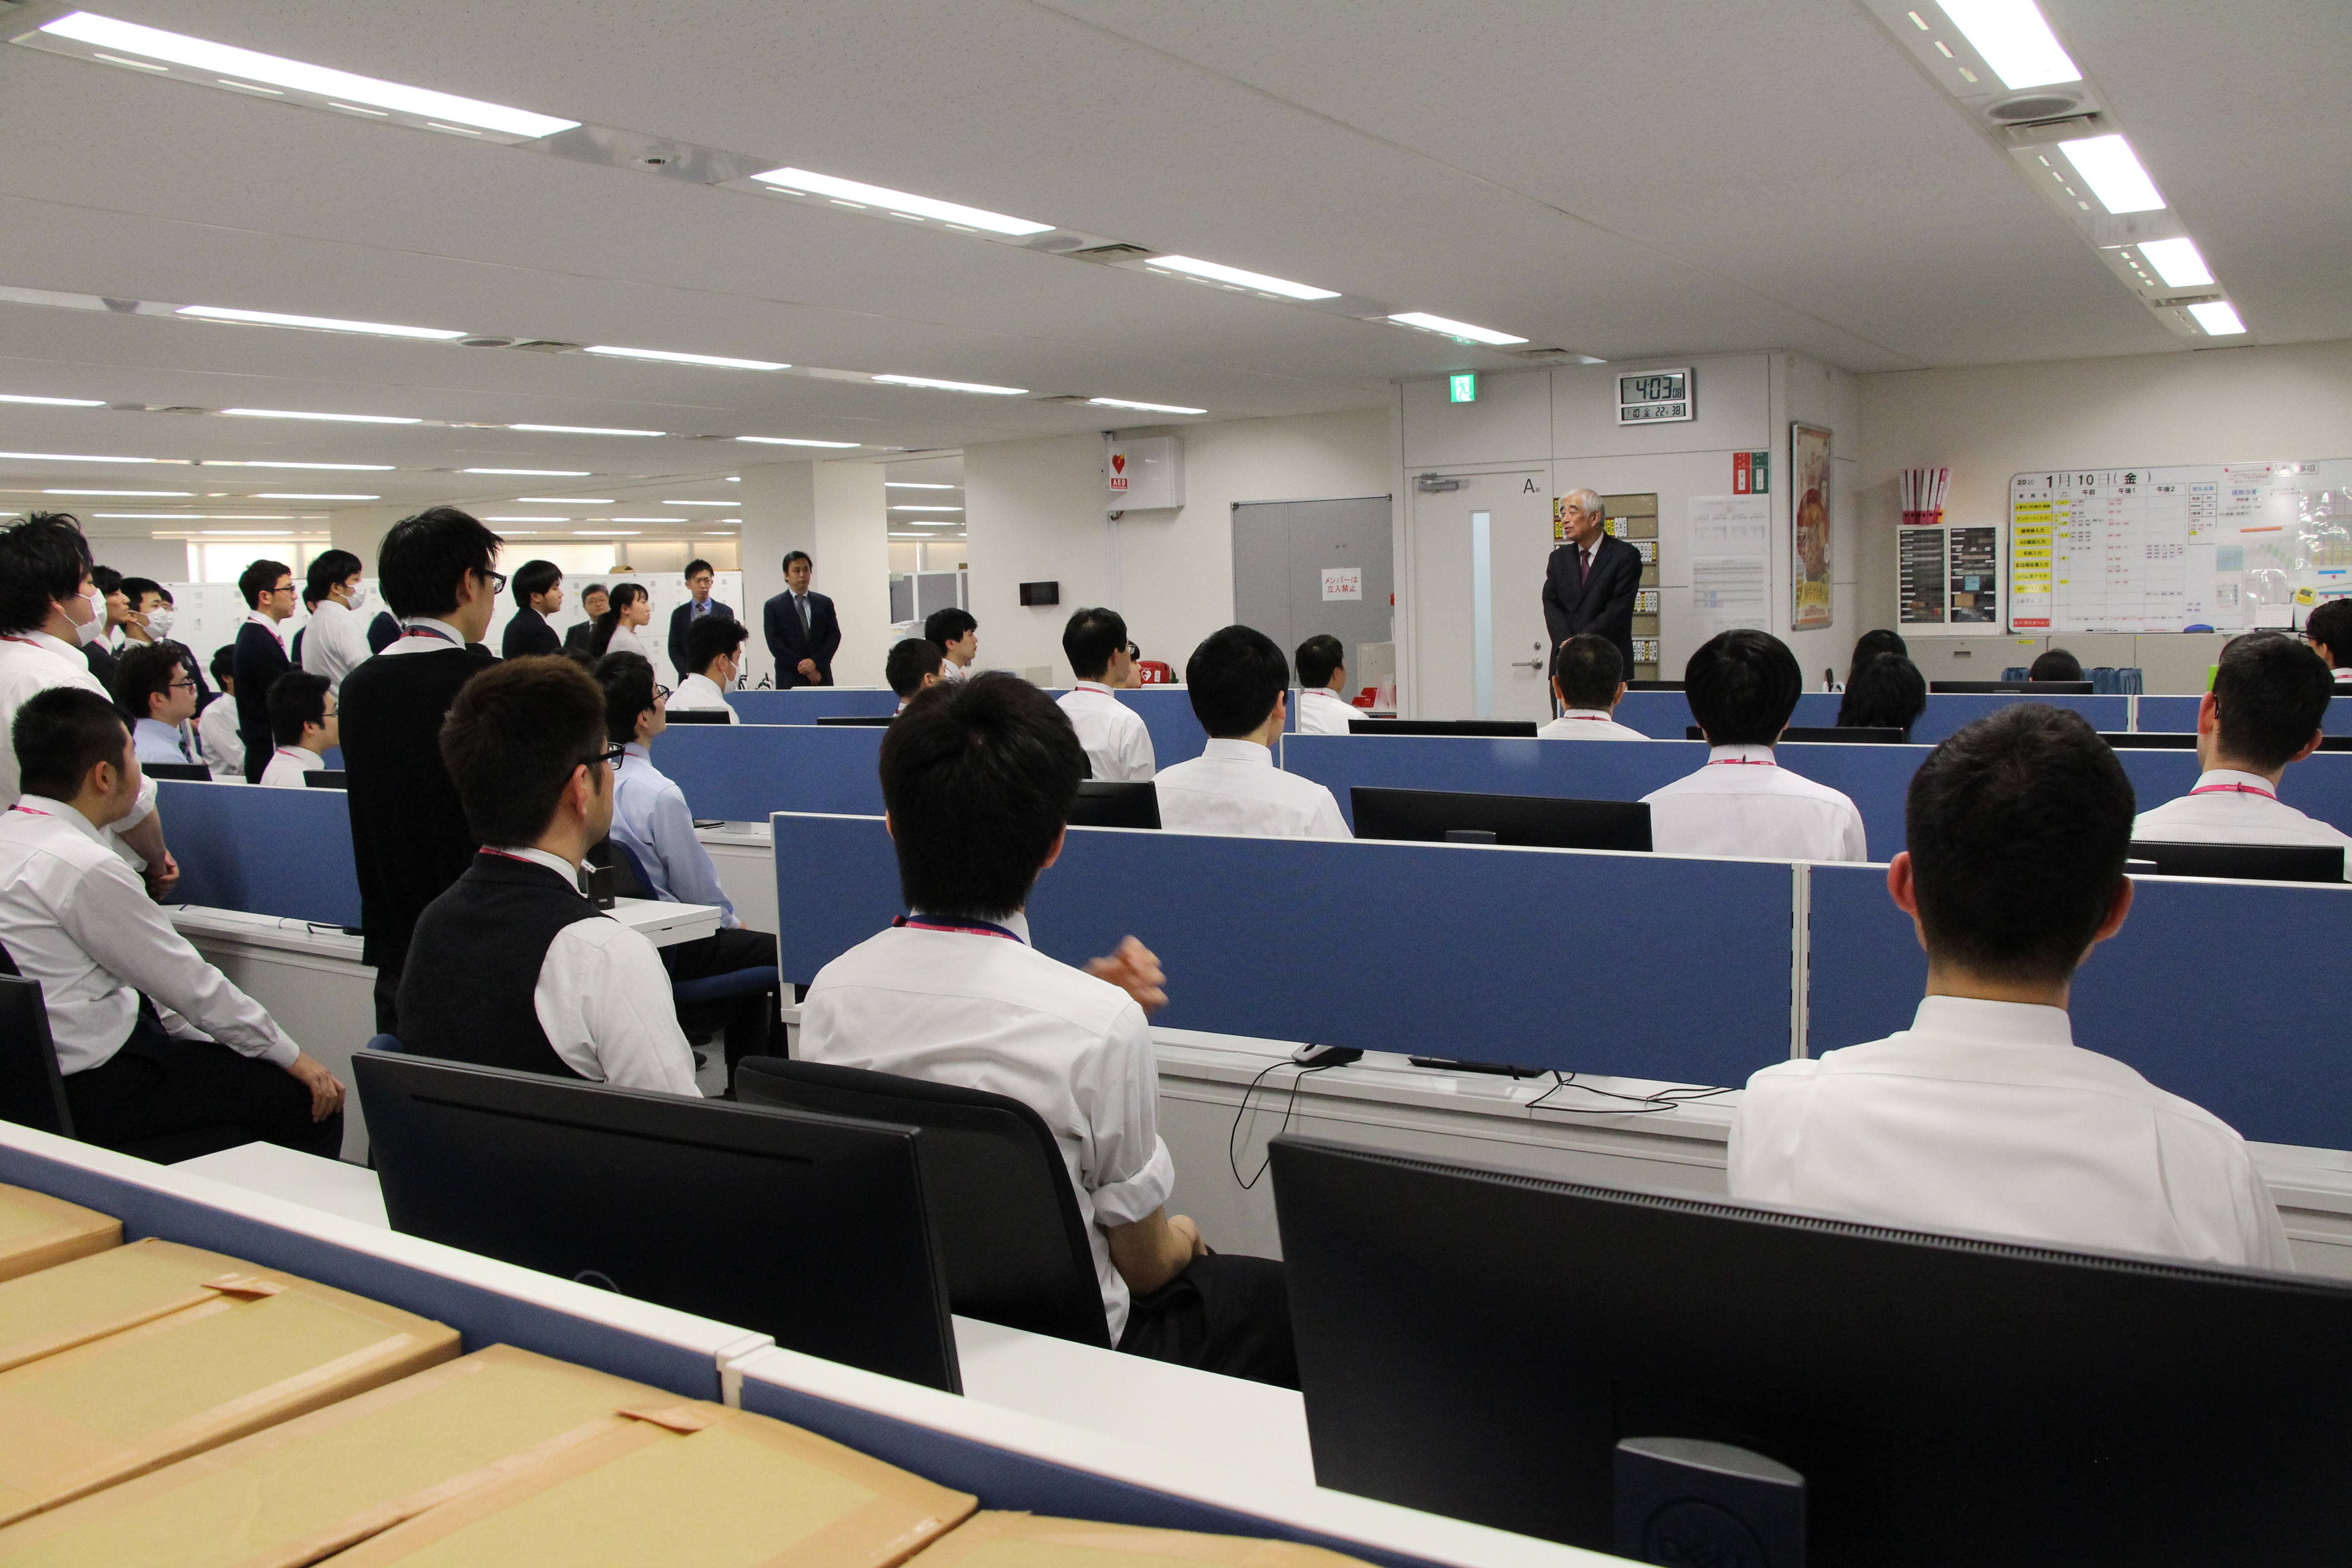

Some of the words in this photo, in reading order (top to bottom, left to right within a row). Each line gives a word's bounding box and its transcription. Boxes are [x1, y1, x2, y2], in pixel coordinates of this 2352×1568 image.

[1636, 377, 1672, 400] 4:03
[1672, 388, 1682, 398] 08
[1523, 478, 1535, 494] A
[1325, 576, 1358, 584] メンバーは
[1327, 584, 1357, 593] 立入禁止
